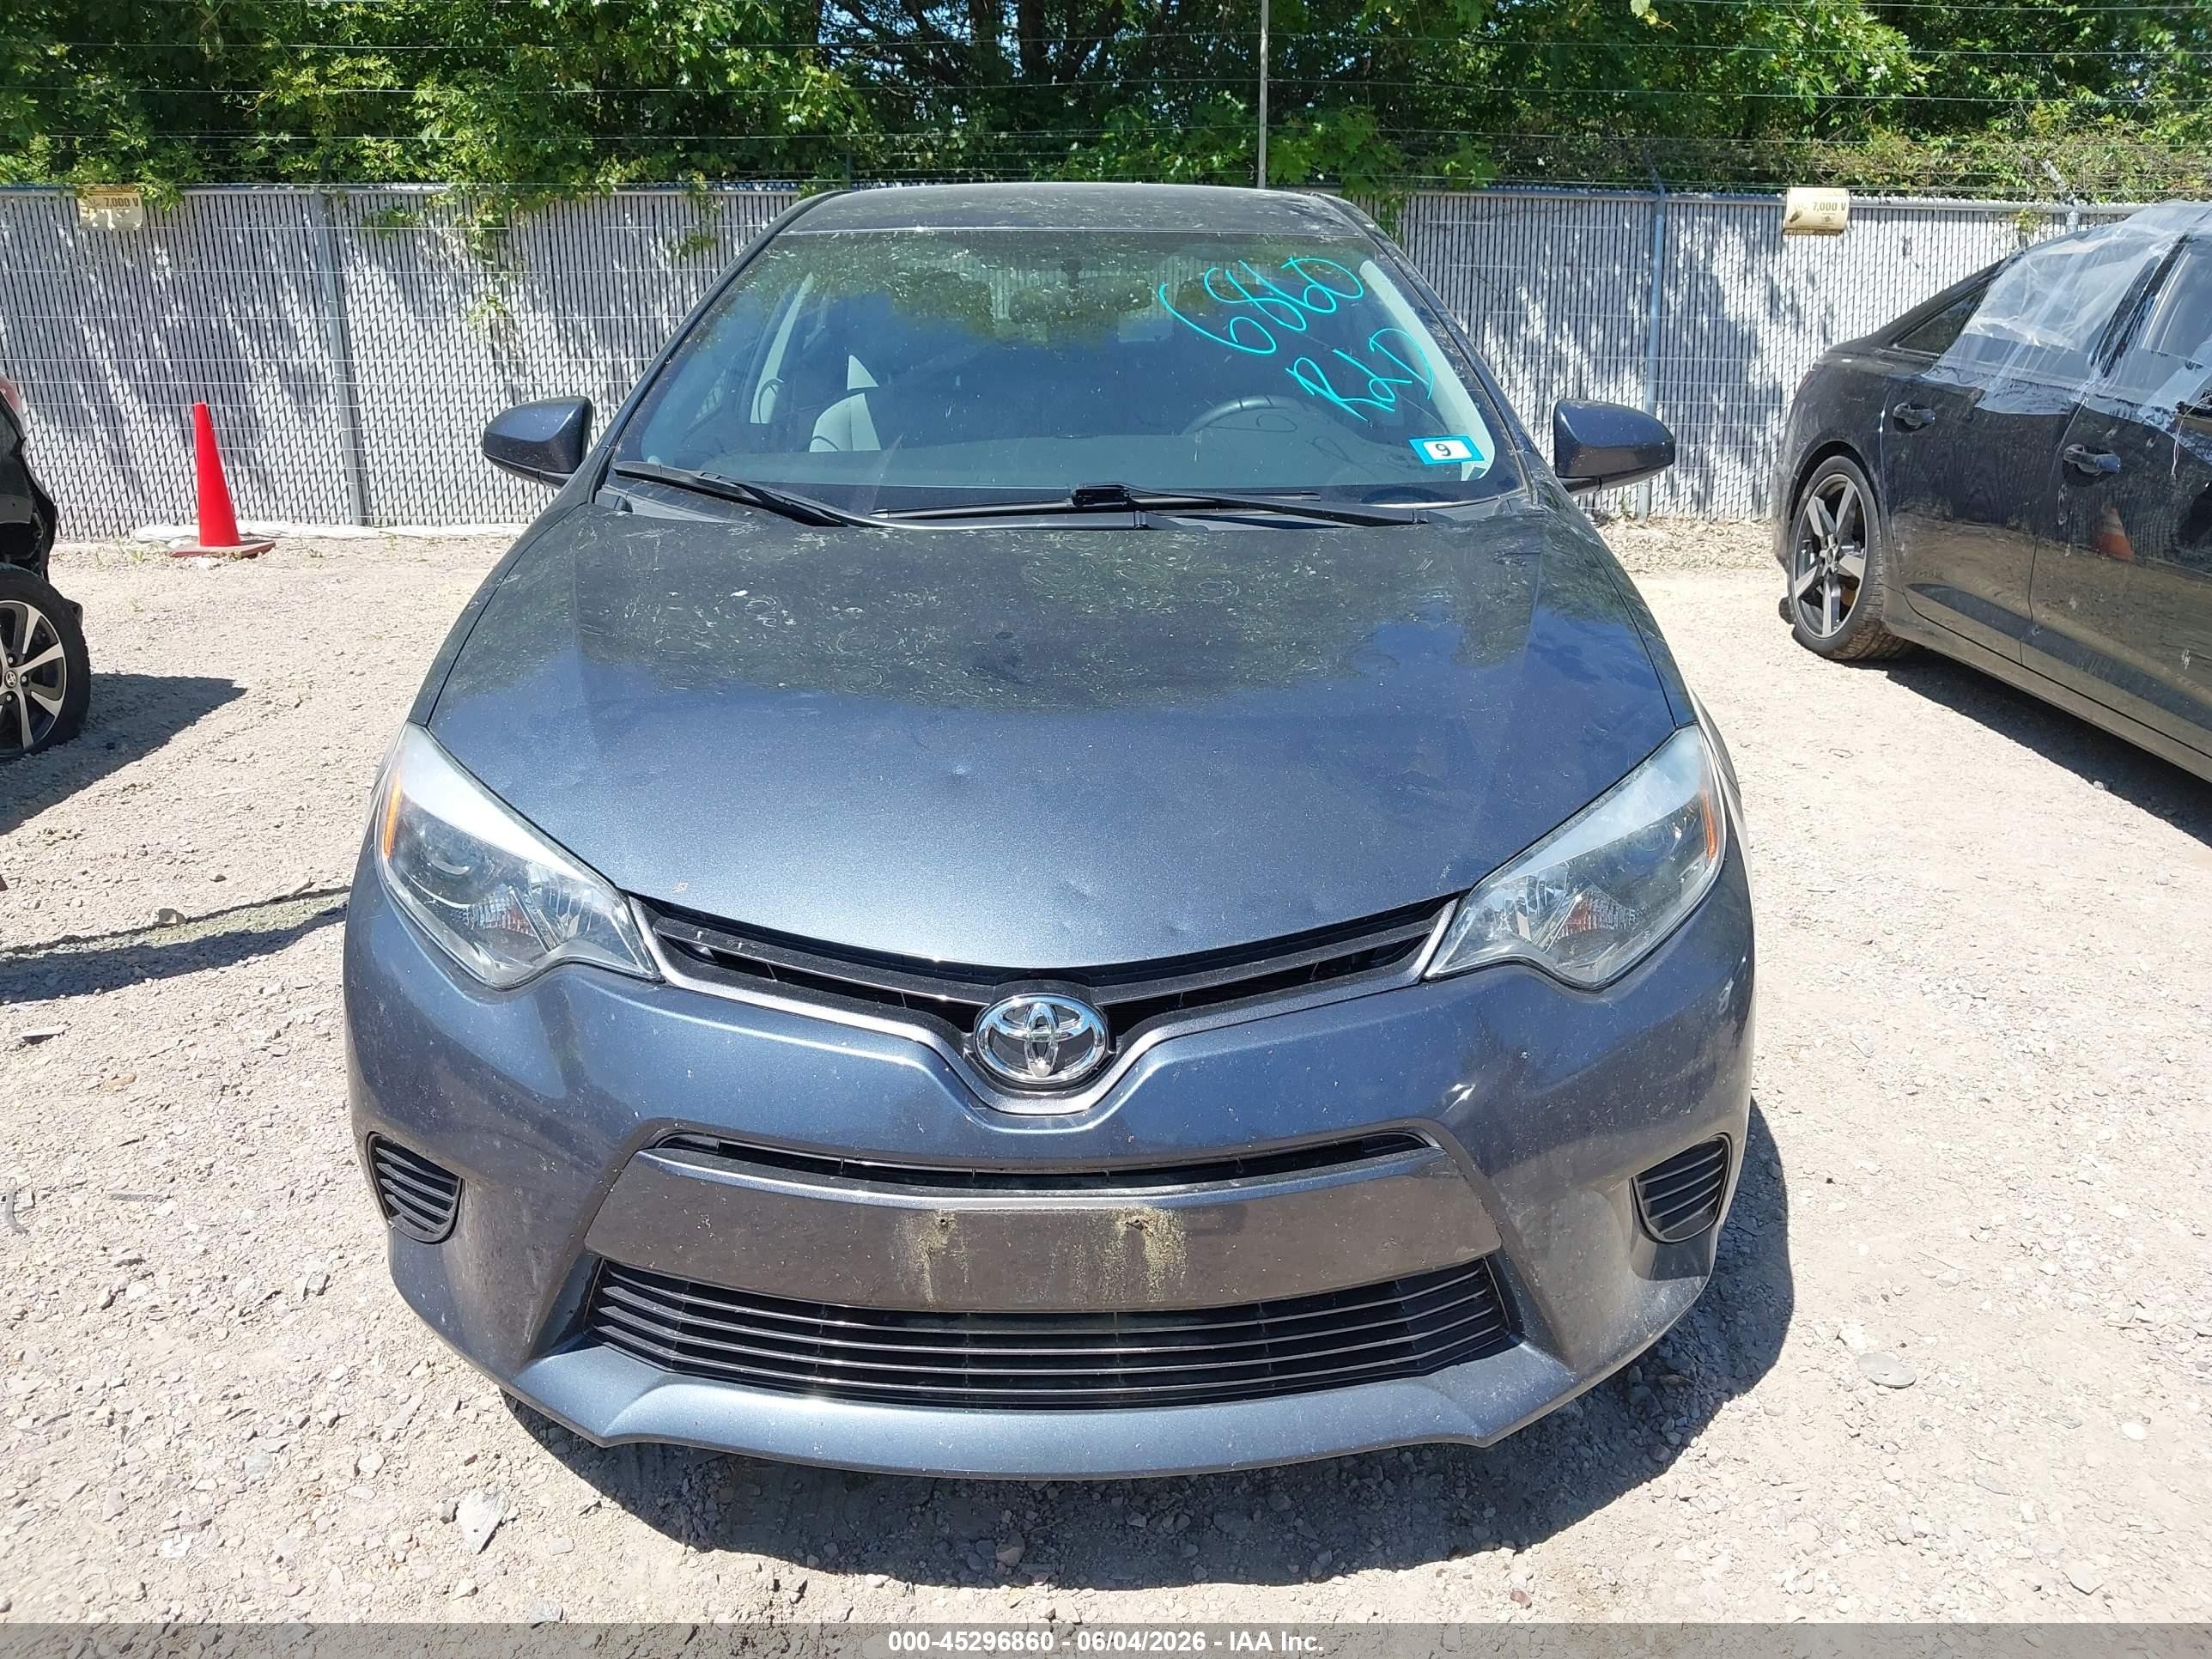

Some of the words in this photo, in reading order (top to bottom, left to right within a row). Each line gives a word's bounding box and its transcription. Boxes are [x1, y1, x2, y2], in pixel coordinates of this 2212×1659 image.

[103, 197, 130, 208] 7,000
[132, 197, 139, 207] V
[1813, 202, 1838, 212] 7,000
[1841, 202, 1847, 211] V
[1435, 443, 1451, 457] 9
